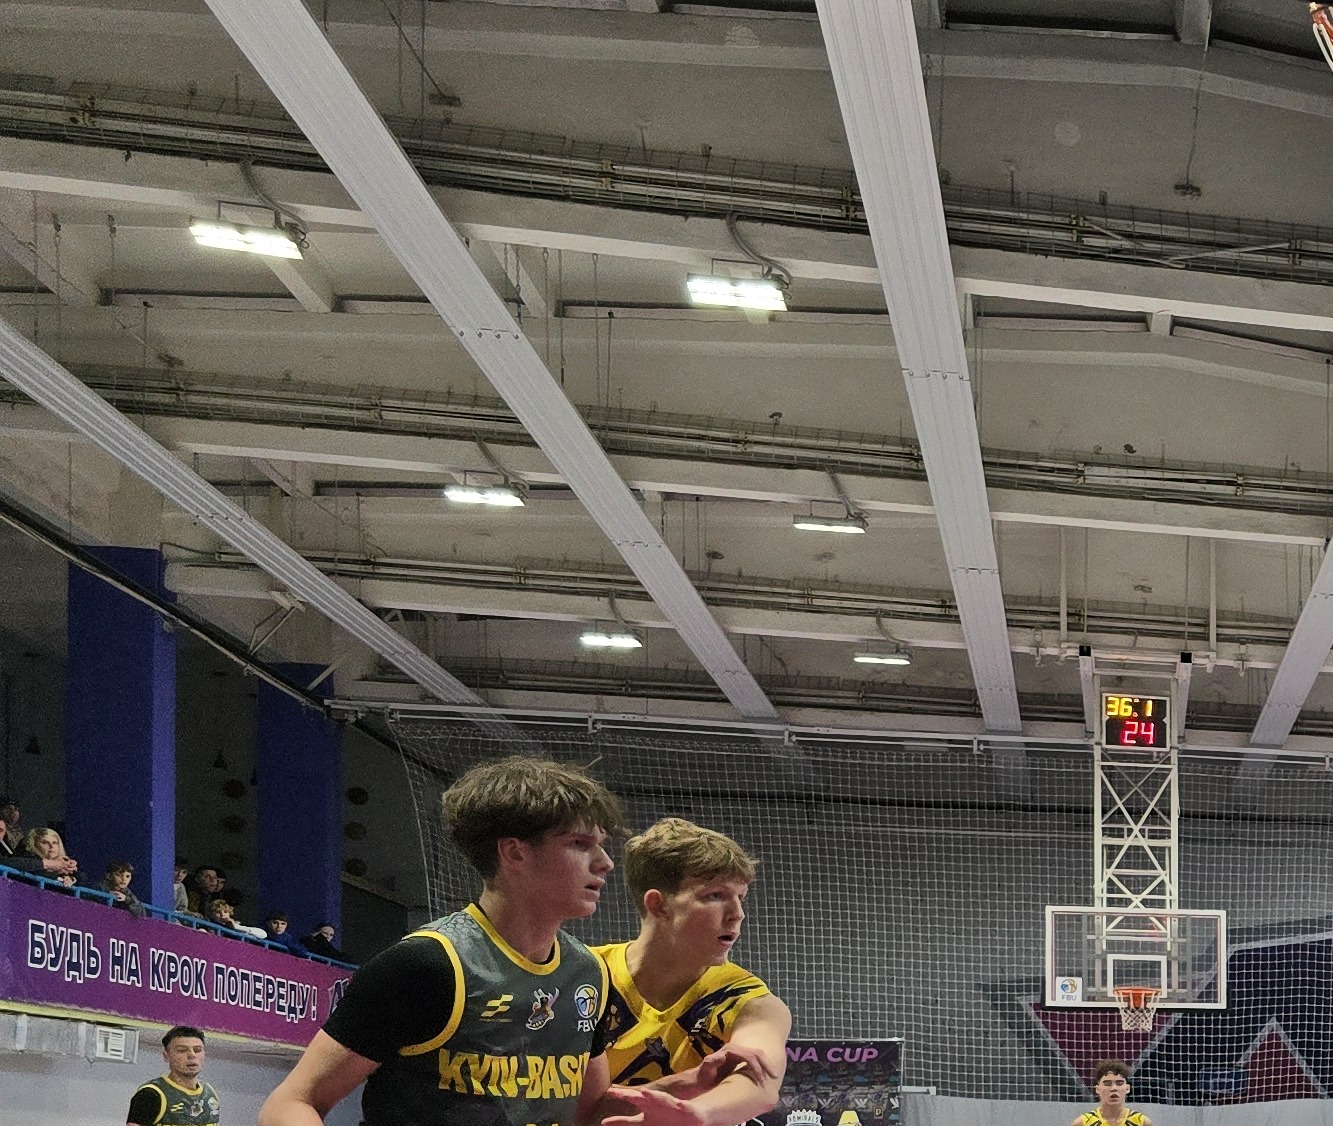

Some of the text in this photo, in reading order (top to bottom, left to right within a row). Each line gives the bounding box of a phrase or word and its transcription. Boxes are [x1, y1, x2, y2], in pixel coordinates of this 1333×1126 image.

[1124, 721, 1155, 745] 24
[28, 919, 318, 1023] БУДЬ НА КРОК ПОПЕРЕДУ!
[827, 1047, 879, 1063] CUP
